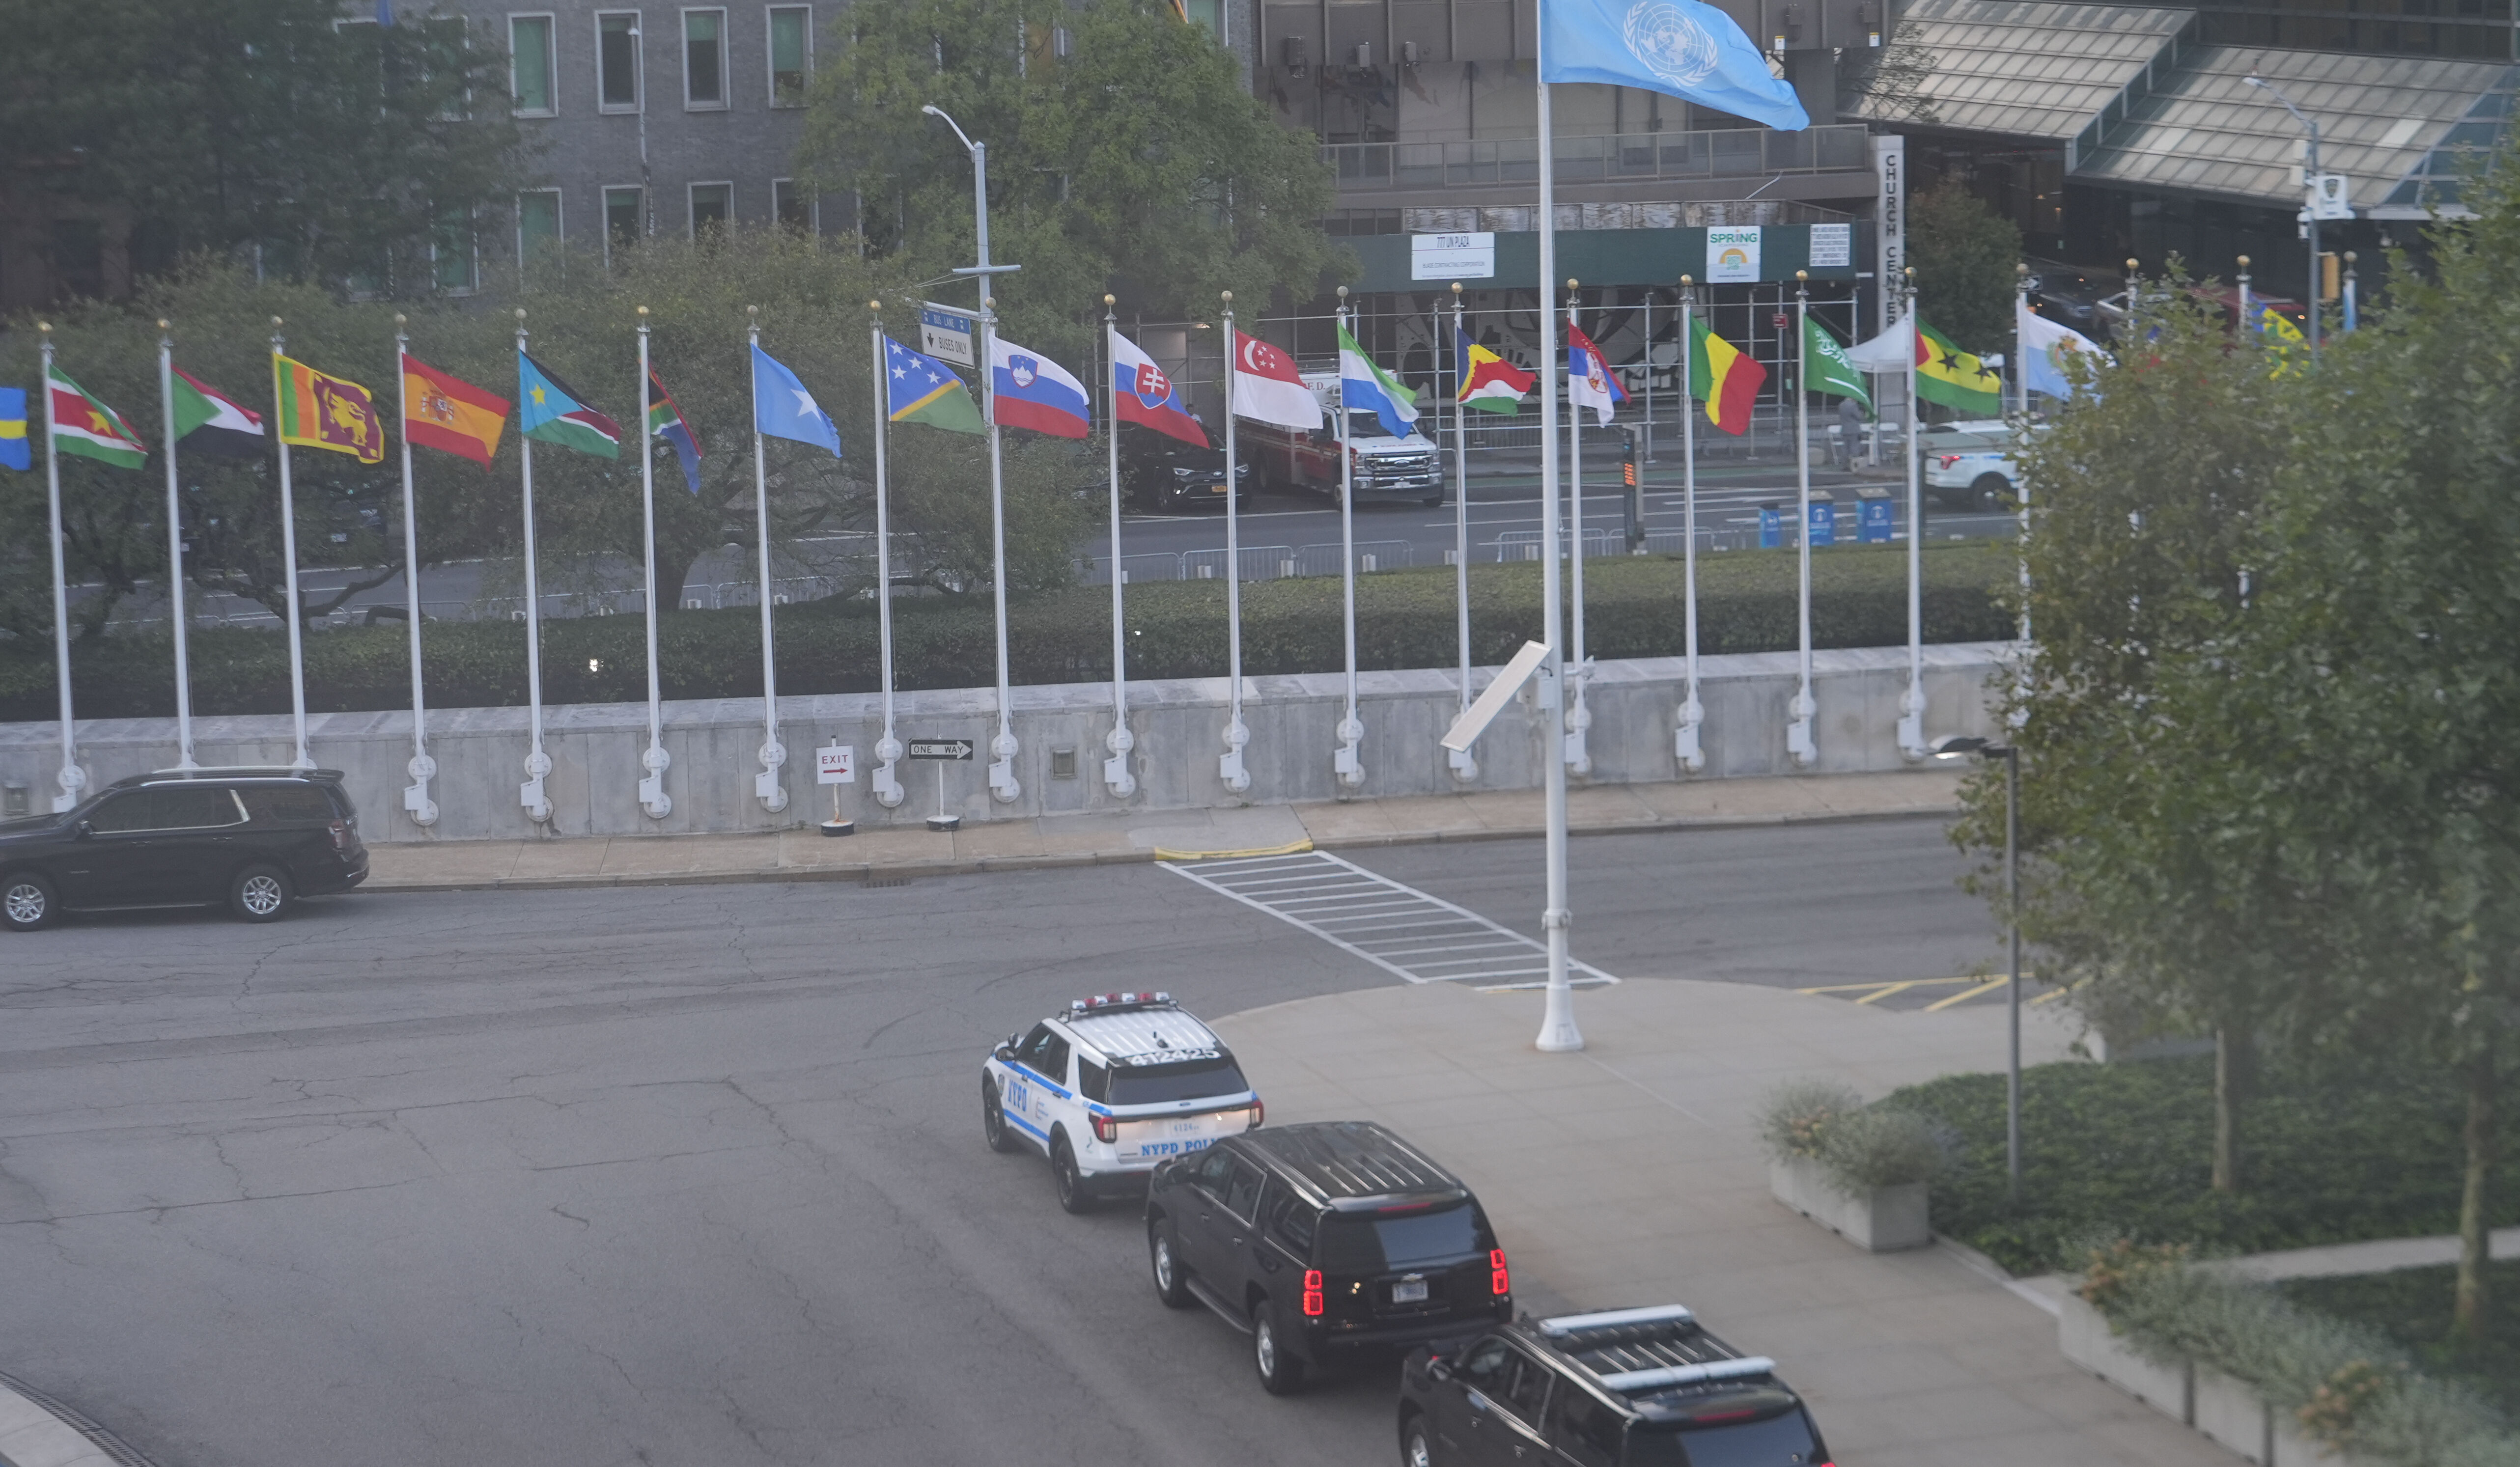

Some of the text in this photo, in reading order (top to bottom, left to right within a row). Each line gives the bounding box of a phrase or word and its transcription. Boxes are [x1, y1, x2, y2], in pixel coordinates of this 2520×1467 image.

[1437, 236, 1470, 248] 777 UN PLAZA
[1886, 155, 1896, 328] CHURCH CENTER
[944, 317, 954, 328] LANE
[939, 336, 967, 355] BUSES ONLY
[913, 745, 964, 754] ONE WAY
[822, 754, 848, 764] EXIT
[1130, 1048, 1221, 1066] 412425
[1008, 1079, 1027, 1112] NYPD
[1142, 1142, 1178, 1156] NYPD
